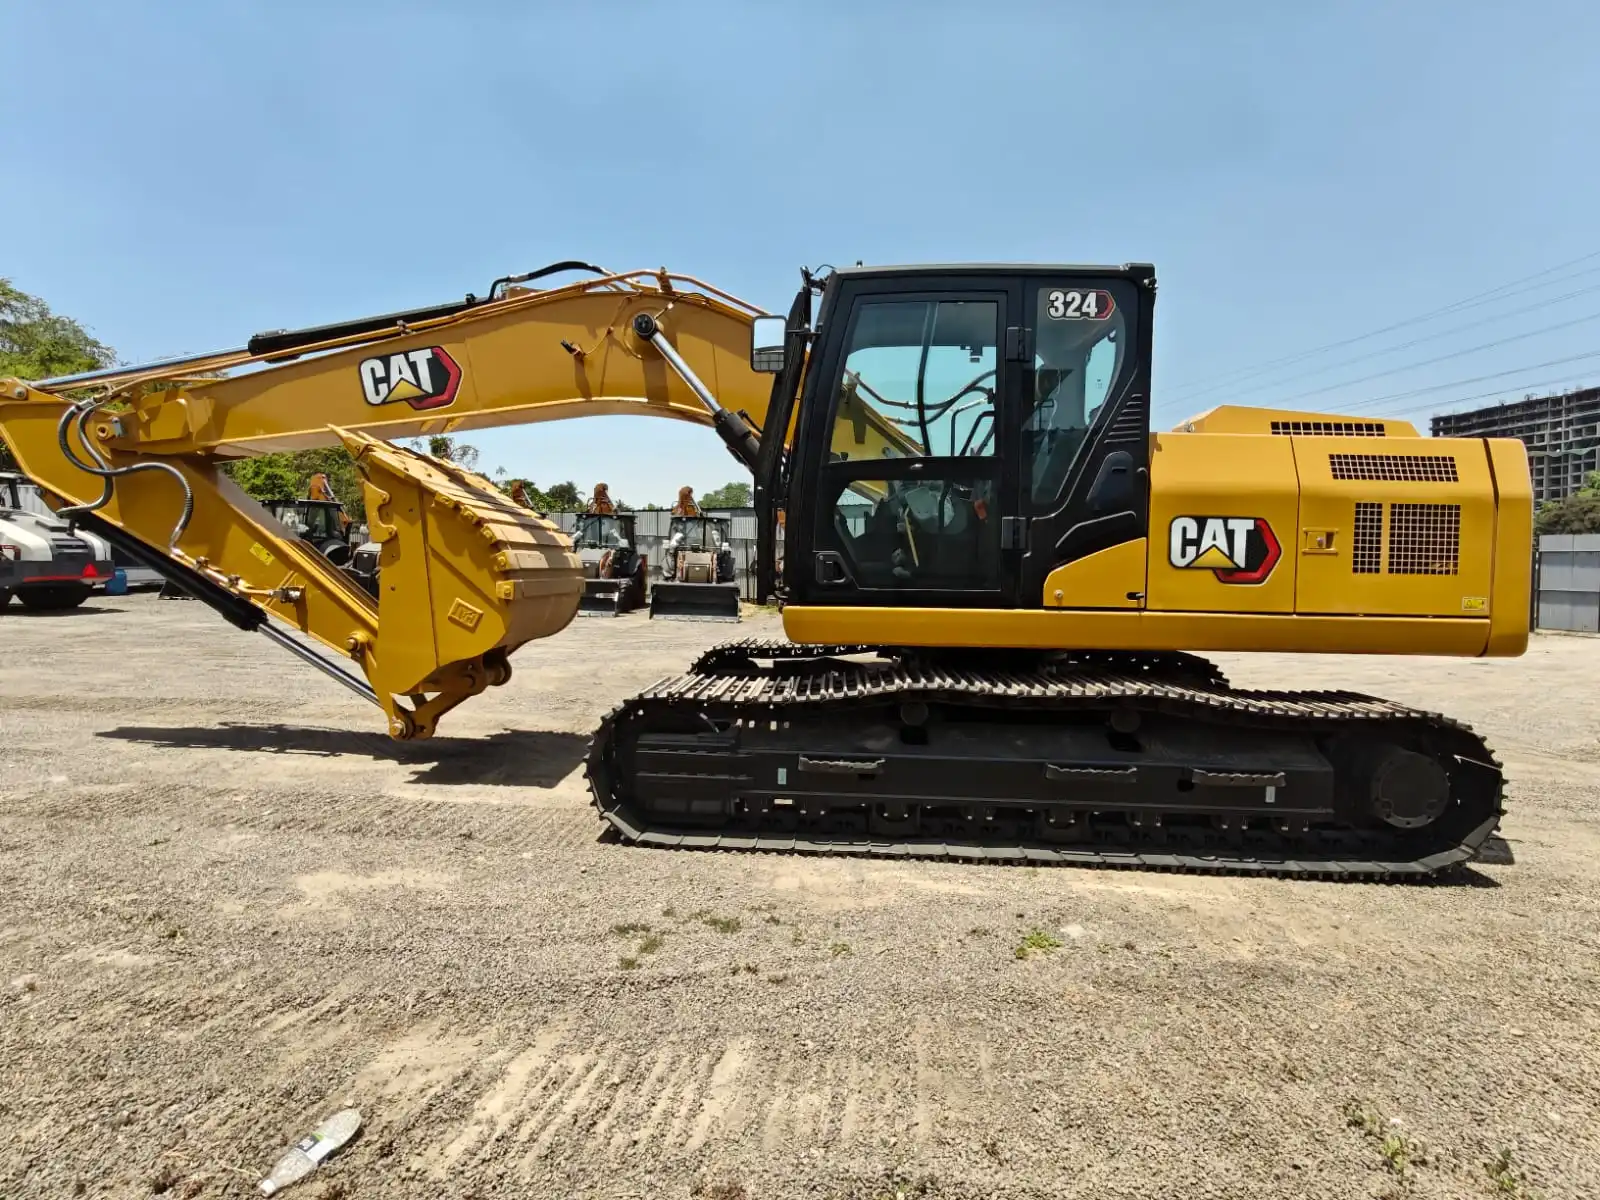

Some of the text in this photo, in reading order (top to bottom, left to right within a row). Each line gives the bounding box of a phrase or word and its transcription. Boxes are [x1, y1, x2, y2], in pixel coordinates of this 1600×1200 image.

[1049, 291, 1097, 317] 324
[360, 348, 433, 404] CAT
[1170, 517, 1254, 568] CAT
